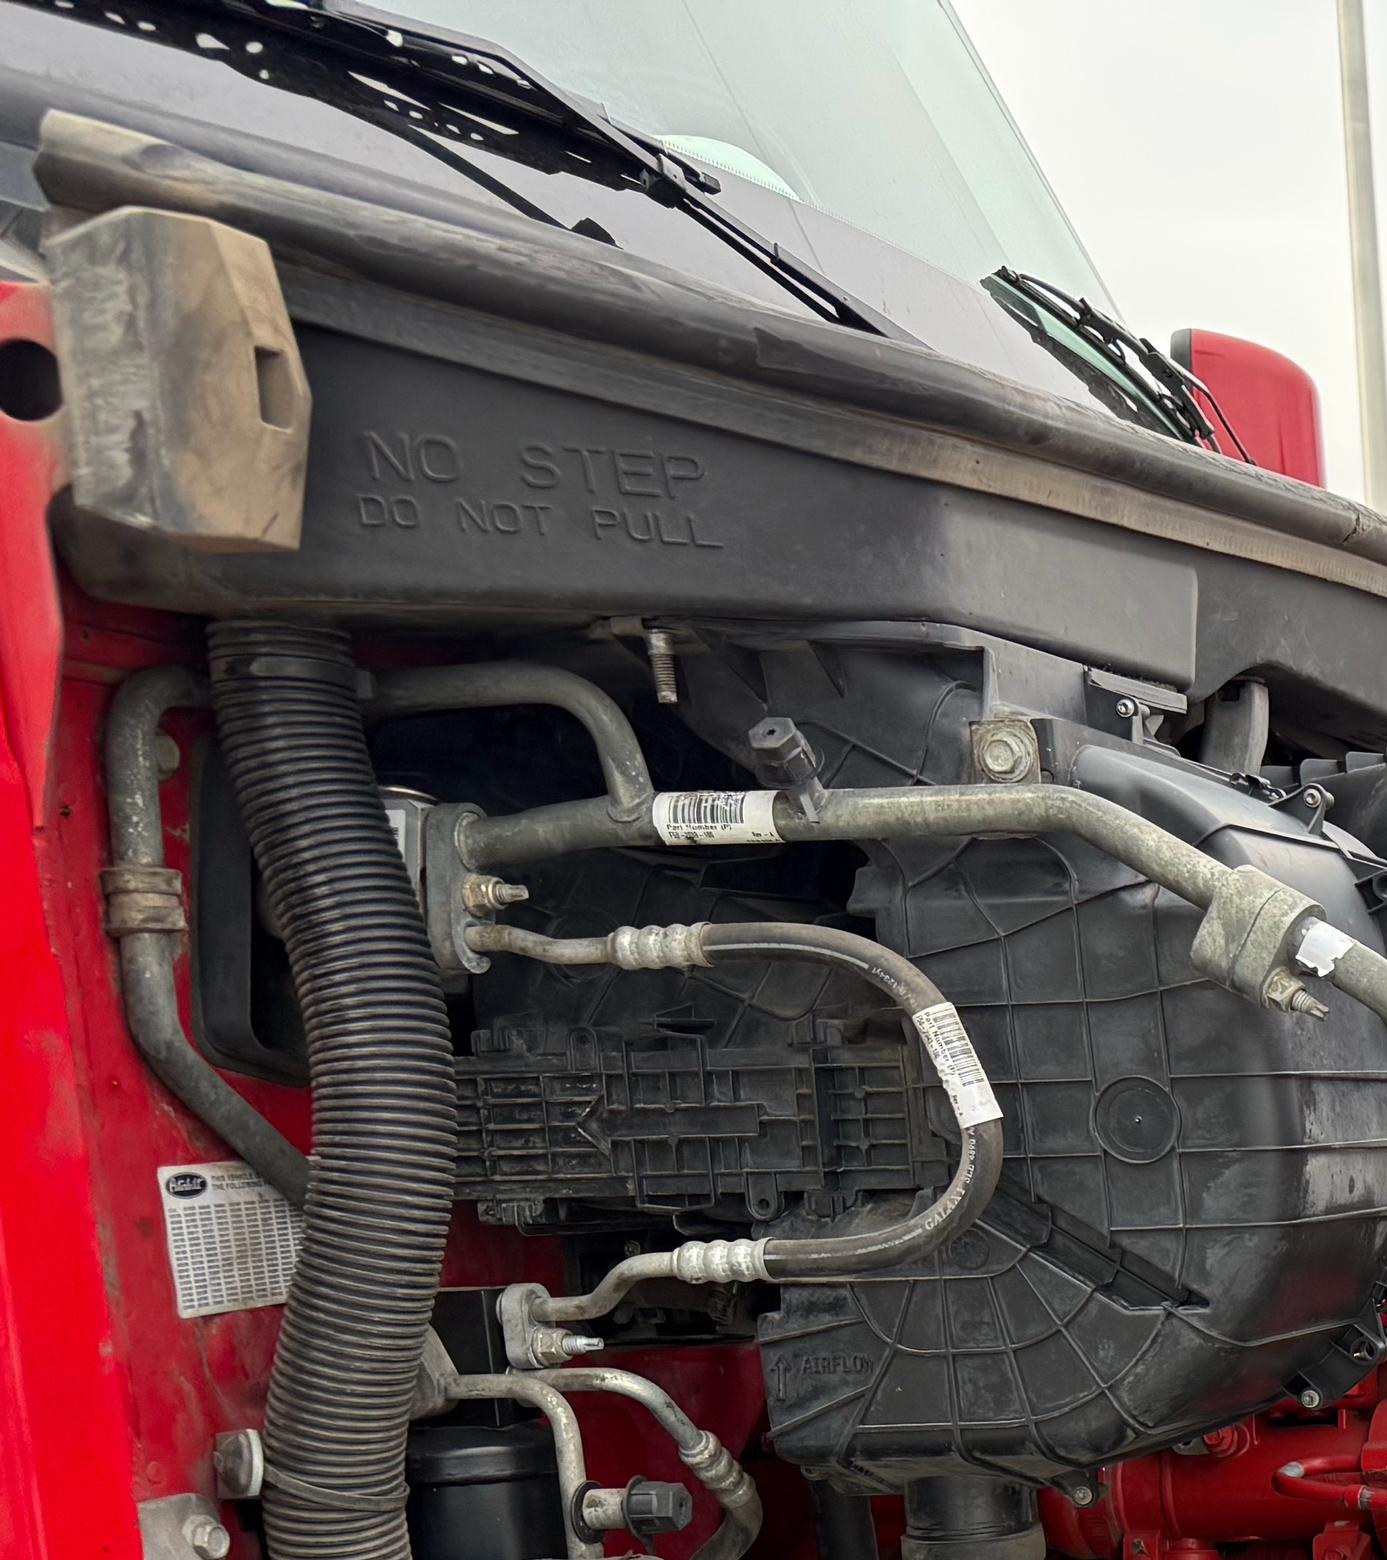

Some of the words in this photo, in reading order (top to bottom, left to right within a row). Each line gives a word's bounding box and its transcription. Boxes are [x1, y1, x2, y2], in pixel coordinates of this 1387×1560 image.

[365, 430, 460, 483] NO
[520, 441, 704, 499] STEP
[357, 494, 418, 528] DO
[455, 499, 552, 536] NOT
[591, 507, 724, 548] PULL
[801, 1354, 873, 1375] AIRFLOW
